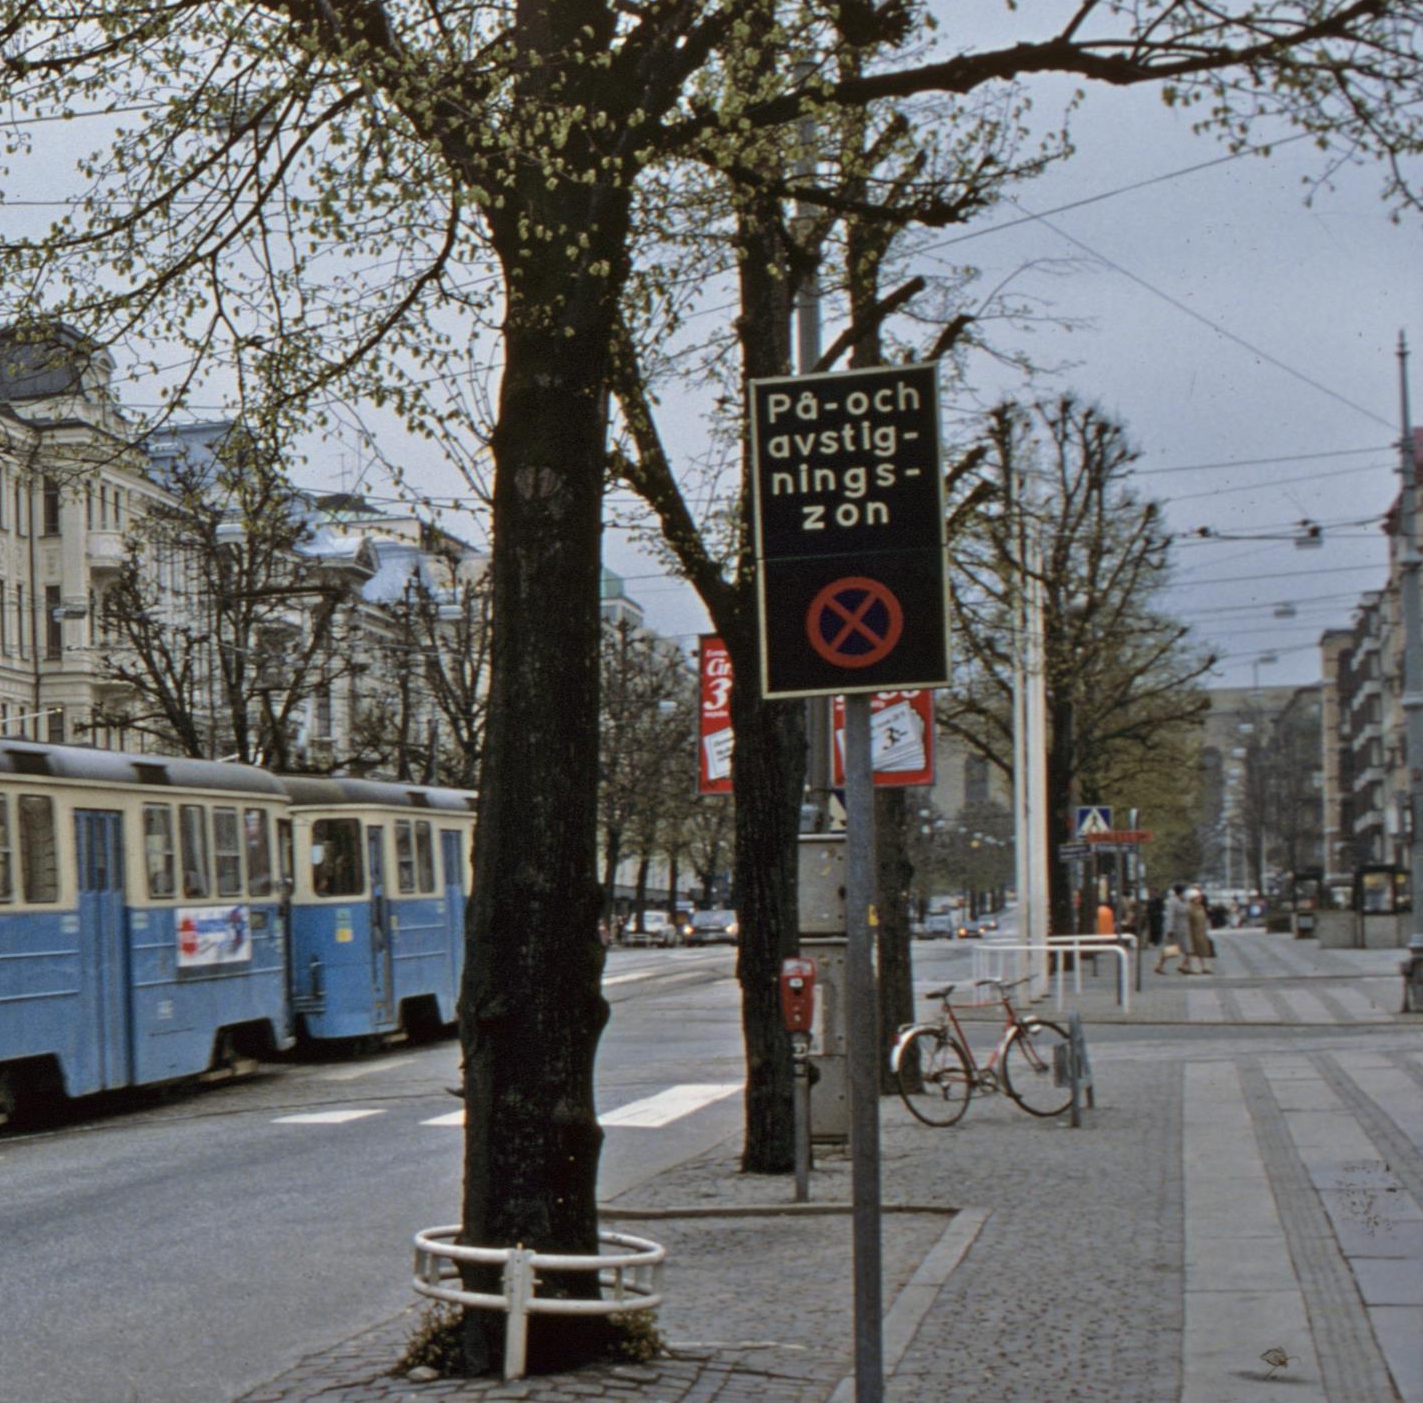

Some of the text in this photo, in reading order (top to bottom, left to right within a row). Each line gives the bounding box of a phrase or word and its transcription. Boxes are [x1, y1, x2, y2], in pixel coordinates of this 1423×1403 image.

[767, 420, 920, 458] avstig-
[771, 462, 922, 499] nings-
[802, 501, 890, 531] zon
